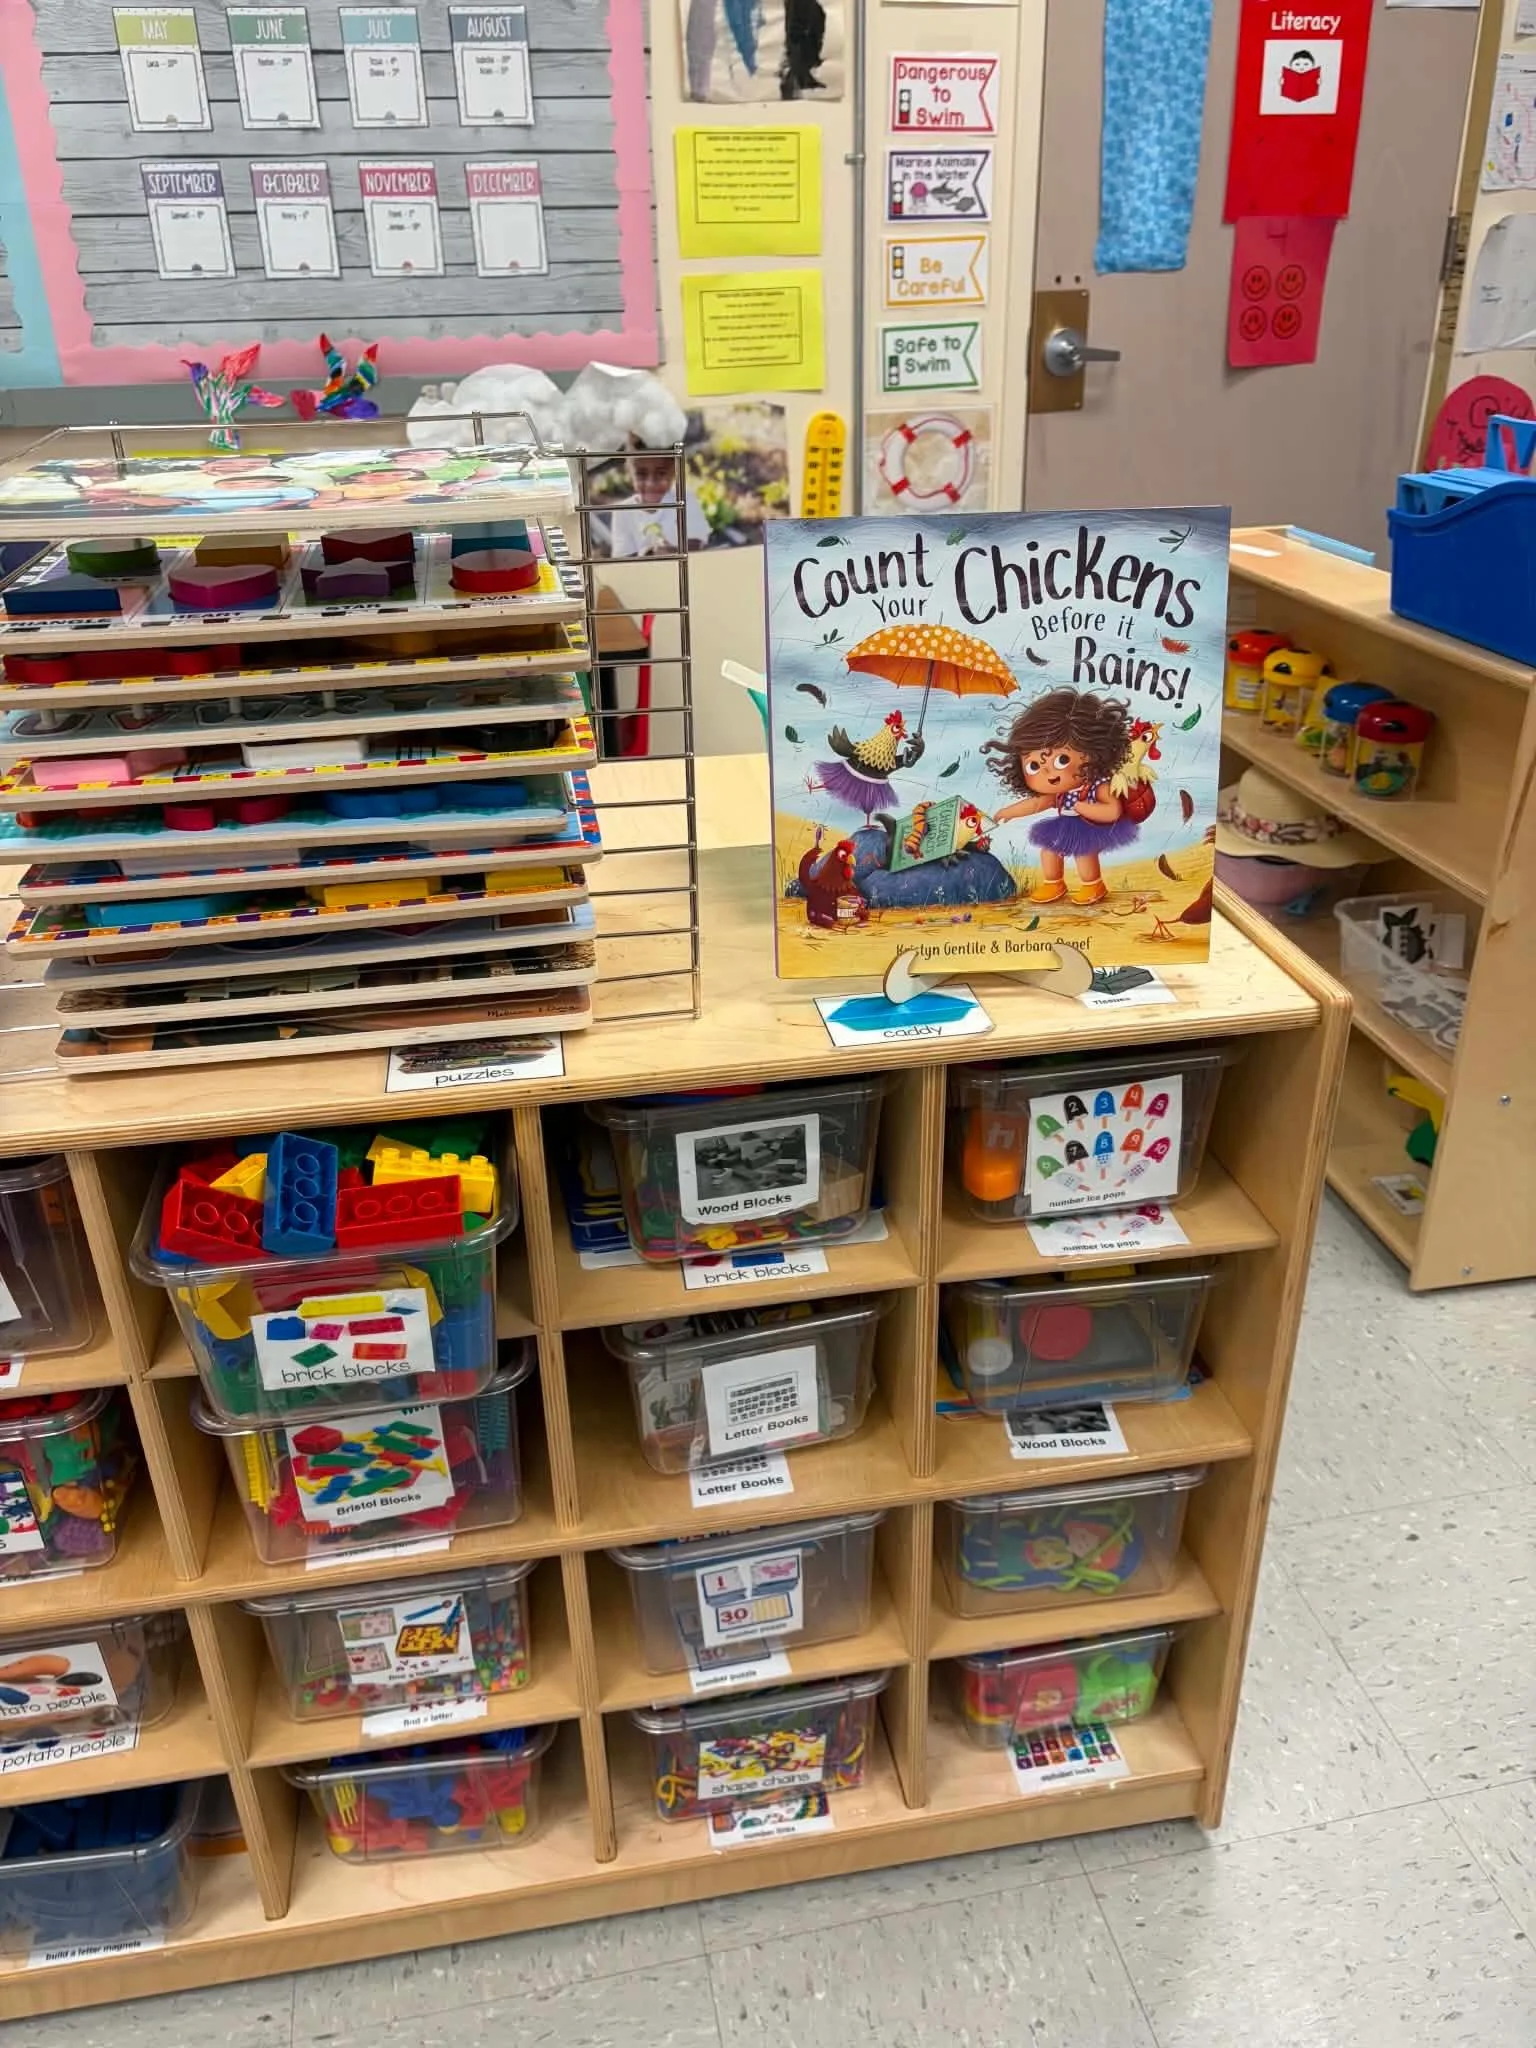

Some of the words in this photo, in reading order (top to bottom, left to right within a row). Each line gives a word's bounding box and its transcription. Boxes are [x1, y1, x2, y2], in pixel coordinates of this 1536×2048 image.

[141, 18, 168, 41] MAY
[255, 17, 286, 40] JUNE
[366, 19, 393, 40] JULY
[467, 16, 513, 38] AUGUST
[1270, 12, 1341, 35] Literacy
[898, 62, 988, 83] Dangerous
[932, 85, 952, 104] to
[916, 106, 965, 126] Swim
[895, 155, 932, 170] Marine
[934, 153, 976, 169] Animals
[147, 172, 217, 194] SEPTEMBER
[262, 173, 321, 194] OCTOBER
[365, 171, 432, 194] NOVEMBER
[472, 171, 535, 194] DECEMBER
[914, 170, 932, 182] the
[935, 168, 969, 182] Water
[920, 257, 942, 275] Be
[897, 276, 965, 298] Careful
[895, 335, 937, 355] Safe
[943, 335, 961, 350] to
[905, 354, 951, 374] Swim
[793, 533, 933, 618] Count
[954, 526, 1201, 628] Chickens
[871, 594, 928, 623] Your
[1031, 605, 1106, 641] Before
[1117, 614, 1136, 640] it
[1073, 635, 1191, 710] Rains!
[943, 940, 986, 955] Gentile
[990, 939, 1001, 953] &
[1005, 937, 1051, 951] Barbara
[884, 1024, 942, 1040] caddy
[435, 1066, 515, 1086] puzzles
[1067, 1101, 1078, 1115] 2
[1098, 1097, 1108, 1110] 3
[1130, 1091, 1139, 1105] 4
[697, 1201, 739, 1216] Wood
[743, 1194, 792, 1209] Blocks
[1049, 1197, 1083, 1209] number
[1087, 1195, 1099, 1204] ice
[1102, 1190, 1125, 1203] pops
[1062, 1243, 1096, 1253] number
[1100, 1242, 1113, 1250] ice
[1116, 1239, 1140, 1250] pops
[703, 1271, 749, 1286] brick
[754, 1262, 811, 1279] blocks
[281, 1366, 336, 1384] brick
[341, 1360, 410, 1380] blocks
[724, 1424, 764, 1442] Letter
[766, 1415, 809, 1432] Books
[1018, 1438, 1057, 1450] Wood
[1059, 1436, 1106, 1449] Blocks
[697, 1481, 737, 1496] Letter
[739, 1475, 784, 1490] Books
[335, 1499, 376, 1516] Bristol
[379, 1492, 421, 1508] Blocks
[719, 1608, 749, 1624] 30
[45, 1690, 108, 1713] people
[3, 1744, 65, 1772] potato
[69, 1734, 127, 1759] people
[710, 1778, 759, 1795] shape
[762, 1772, 811, 1787] chains
[45, 1952, 69, 1961] build
